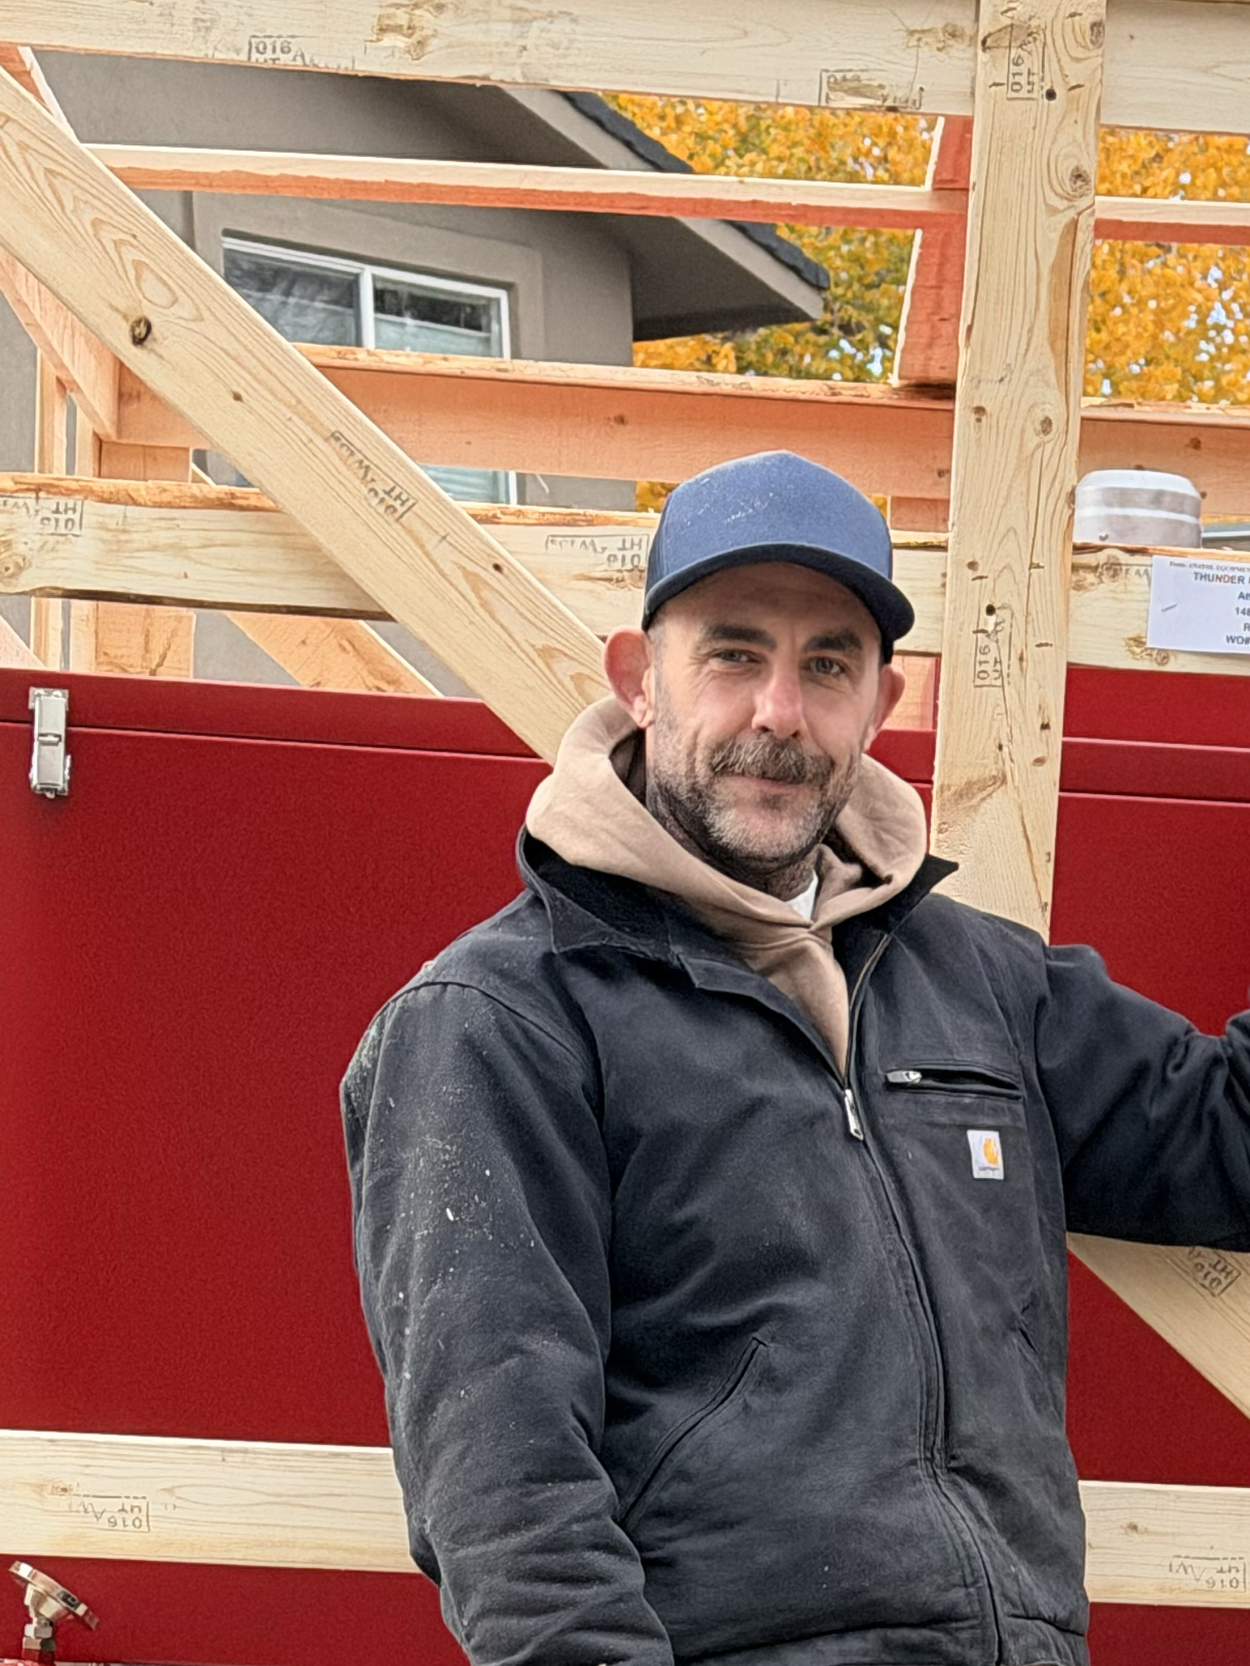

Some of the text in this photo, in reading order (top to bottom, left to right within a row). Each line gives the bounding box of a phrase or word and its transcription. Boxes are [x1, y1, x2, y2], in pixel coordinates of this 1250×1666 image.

[254, 40, 292, 55] 016
[381, 481, 411, 508] HT
[52, 501, 77, 515] HT
[617, 538, 642, 551] HT
[1193, 571, 1245, 585] THUNDER
[977, 644, 989, 680] 016
[1208, 1254, 1235, 1280] HT
